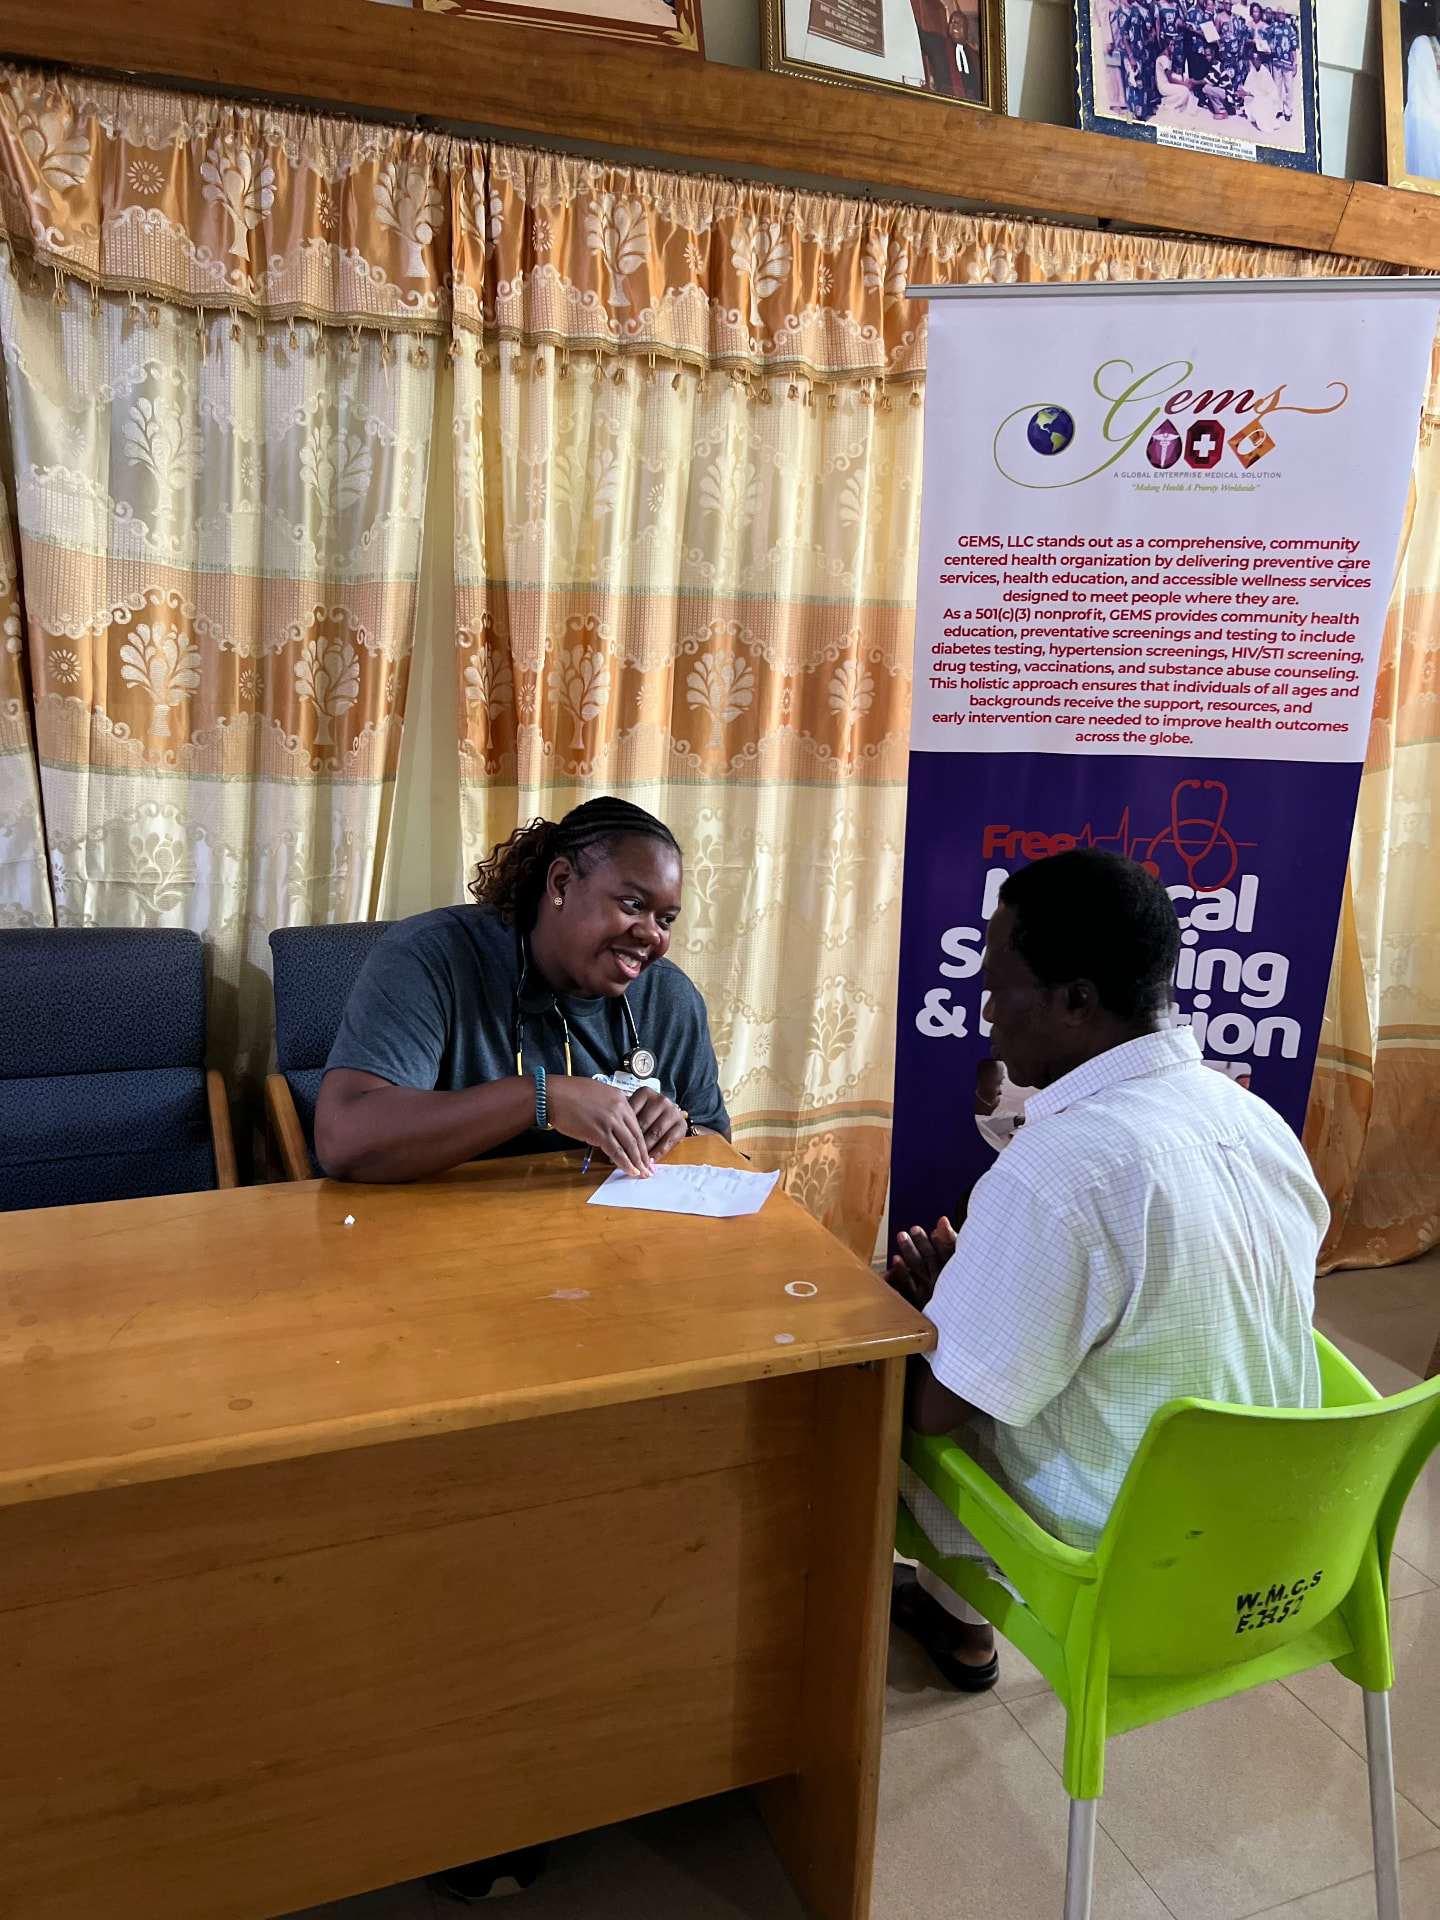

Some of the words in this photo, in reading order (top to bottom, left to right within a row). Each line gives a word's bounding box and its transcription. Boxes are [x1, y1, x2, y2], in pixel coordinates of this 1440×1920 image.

[1162, 483, 1184, 492] Health
[958, 534, 1004, 548] GEMS,
[1007, 535, 1034, 547] LLC
[1036, 535, 1086, 547] stands
[1088, 535, 1114, 547] out
[1116, 539, 1133, 548] as
[1136, 539, 1144, 548] a
[1148, 536, 1266, 552] comprehensive,
[1270, 537, 1360, 552] community
[944, 553, 1008, 565] centered
[1011, 553, 1057, 565] health
[1060, 554, 1151, 569] organization
[1154, 555, 1174, 569] by
[1176, 555, 1250, 570] delivering
[1253, 556, 1334, 571] preventive
[1337, 559, 1371, 568] care
[940, 571, 1000, 585] services,
[1003, 572, 1048, 584] health
[1052, 572, 1128, 586] education,
[1131, 573, 1160, 585] and
[1162, 573, 1238, 586] accessible
[1241, 574, 1306, 586] wellness
[1309, 575, 1371, 587] services
[1002, 589, 1069, 605] designed
[1071, 590, 1087, 602] to
[1090, 590, 1129, 602] meet
[1131, 591, 1182, 606] people
[1185, 592, 1232, 604] where
[1235, 592, 1270, 607] they
[1272, 596, 1299, 604] are.
[942, 607, 961, 618] As
[964, 610, 972, 618] a
[975, 607, 1031, 621] 501(c)(3)
[1034, 608, 1106, 623] nonprofit,
[1109, 609, 1152, 621] GEMS
[1155, 610, 1218, 624] provides
[1220, 611, 1308, 626] community
[1310, 612, 1360, 624] health
[944, 624, 1018, 638] education,
[1020, 625, 1110, 641] preventative
[1112, 627, 1191, 642] screenings
[1194, 628, 1223, 640] and
[1226, 628, 1278, 644] testing
[1280, 629, 1296, 641] to
[1300, 630, 1356, 642] include
[931, 642, 991, 654] diabetes
[994, 643, 1046, 657] testing,
[1049, 644, 1143, 659] hypertension
[1145, 646, 1228, 660] screenings,
[1232, 647, 1284, 660] HIV/STI
[1287, 648, 1364, 663] screening,
[932, 660, 966, 673] drug
[969, 659, 1021, 674] testing,
[1024, 660, 1115, 675] vaccinations,
[1118, 662, 1146, 674] and
[1148, 663, 1224, 676] substance
[1226, 664, 1271, 676] abuse
[1274, 665, 1359, 681] counseling.
[929, 677, 958, 688] This
[960, 676, 1010, 688] holistic
[1012, 677, 1078, 692] approach
[1082, 682, 1137, 691] ensures
[1140, 680, 1170, 692] that
[1173, 681, 1251, 694] individuals
[1254, 683, 1270, 694] of
[1272, 683, 1289, 694] all
[1292, 687, 1328, 698] ages
[1330, 685, 1360, 696] and
[970, 695, 1061, 709] backgrounds
[1064, 696, 1114, 708] receive
[1117, 697, 1141, 708] the
[1144, 698, 1204, 712] support,
[1207, 702, 1280, 713] resources,
[1283, 701, 1313, 712] and
[932, 712, 966, 725] early
[968, 710, 1052, 723] intervention
[1055, 715, 1086, 724] care
[1088, 714, 1142, 726] needed
[1144, 715, 1160, 726] to
[1162, 716, 1222, 730] improve
[1225, 718, 1272, 729] health
[1275, 719, 1349, 731] outcomes
[1075, 733, 1120, 742] across
[1122, 731, 1147, 742] the
[1149, 732, 1193, 746] globe.
[982, 825, 1077, 859] Free
[915, 987, 969, 1038] &
